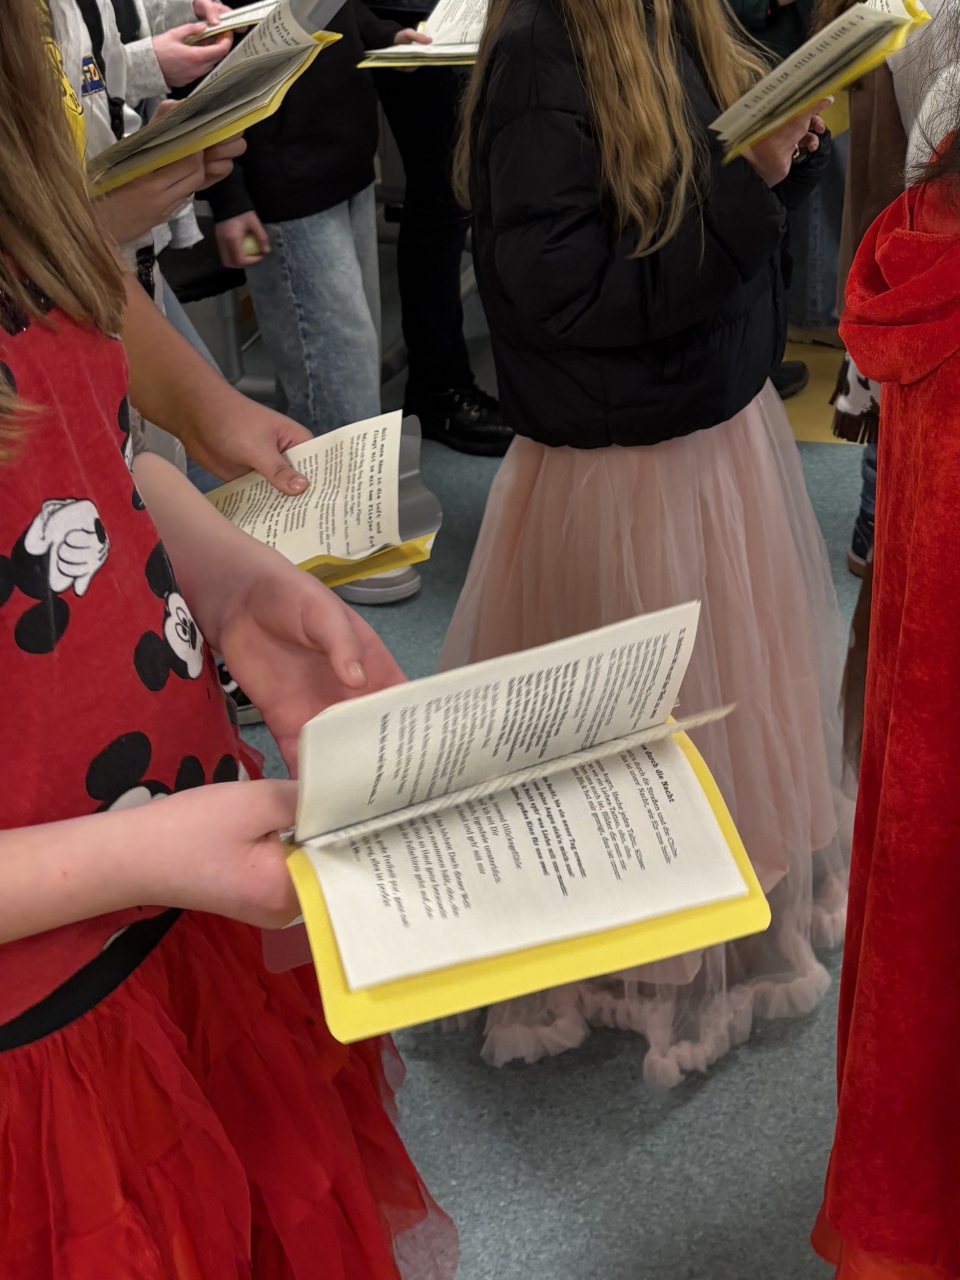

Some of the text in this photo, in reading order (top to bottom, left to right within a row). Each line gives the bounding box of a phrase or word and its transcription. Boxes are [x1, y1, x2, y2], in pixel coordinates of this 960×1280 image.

[602, 772, 614, 790] Augen,
[619, 753, 629, 763] das
[636, 787, 650, 808] Nacht,
[633, 760, 644, 776] durch
[641, 776, 650, 786] die
[646, 786, 661, 811] Straßen
[656, 811, 666, 825] und
[644, 750, 658, 768] durch
[654, 769, 664, 779] die
[659, 780, 676, 802] Nacht
[567, 838, 577, 850] Tag
